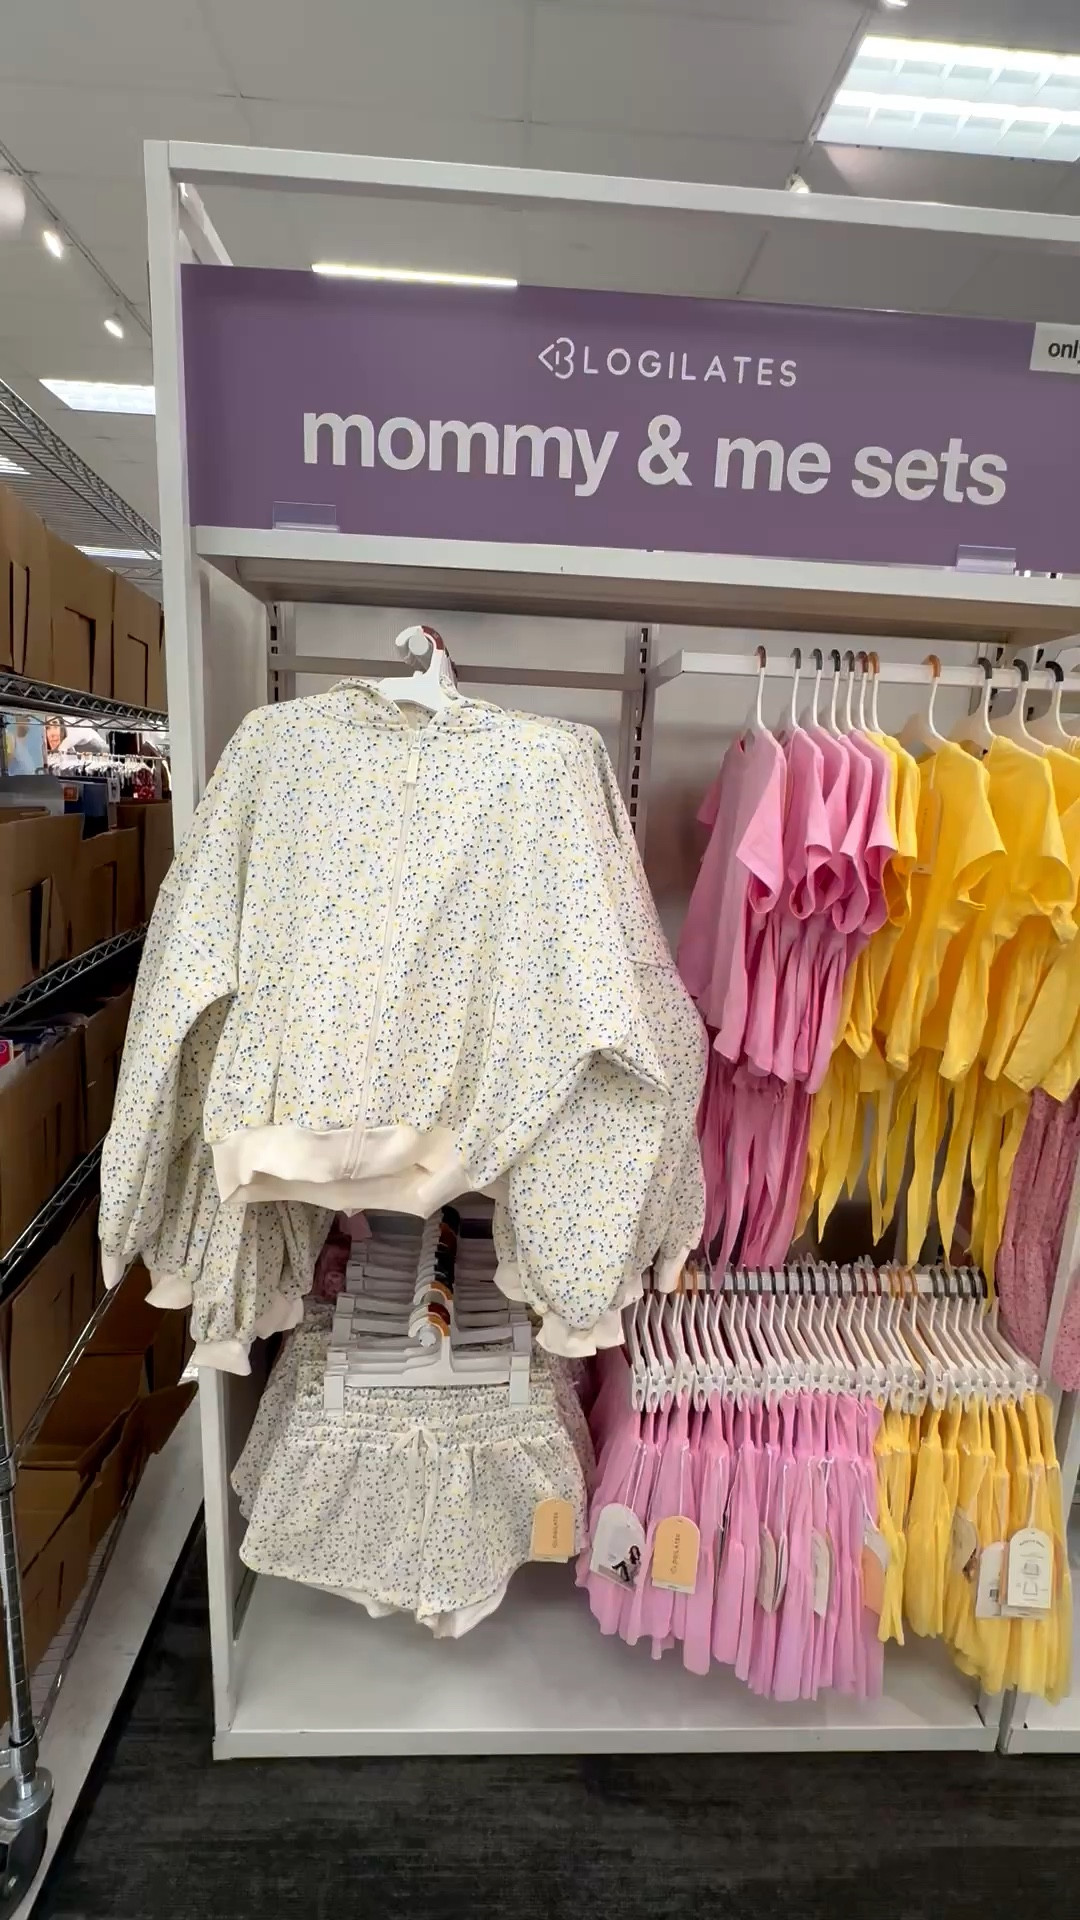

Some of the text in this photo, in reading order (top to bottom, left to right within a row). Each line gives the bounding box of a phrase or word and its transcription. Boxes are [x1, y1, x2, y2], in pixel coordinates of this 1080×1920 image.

[1048, 339, 1080, 364] onl
[303, 412, 1008, 506] mommy & me sets
